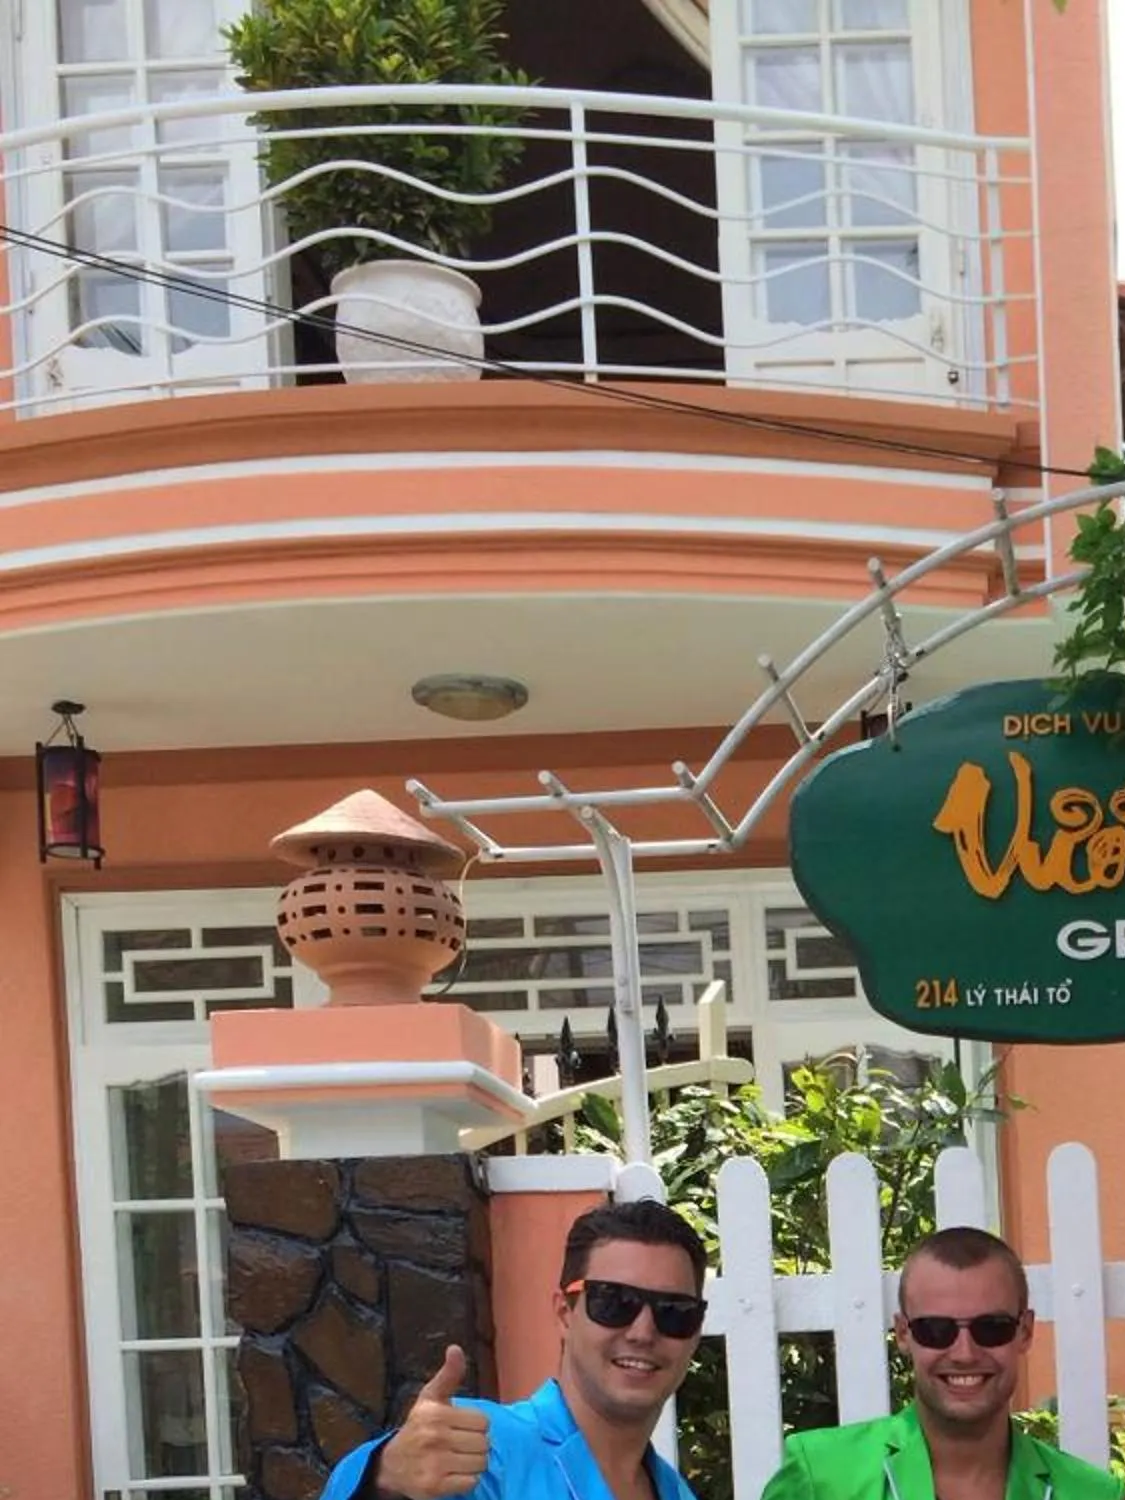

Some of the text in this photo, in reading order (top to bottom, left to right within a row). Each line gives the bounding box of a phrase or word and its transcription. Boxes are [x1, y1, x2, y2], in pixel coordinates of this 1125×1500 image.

[1002, 712, 1072, 741] DỊCH
[915, 977, 959, 1009] 214
[965, 982, 987, 1006] LÝ
[994, 980, 1039, 1006] THÁI
